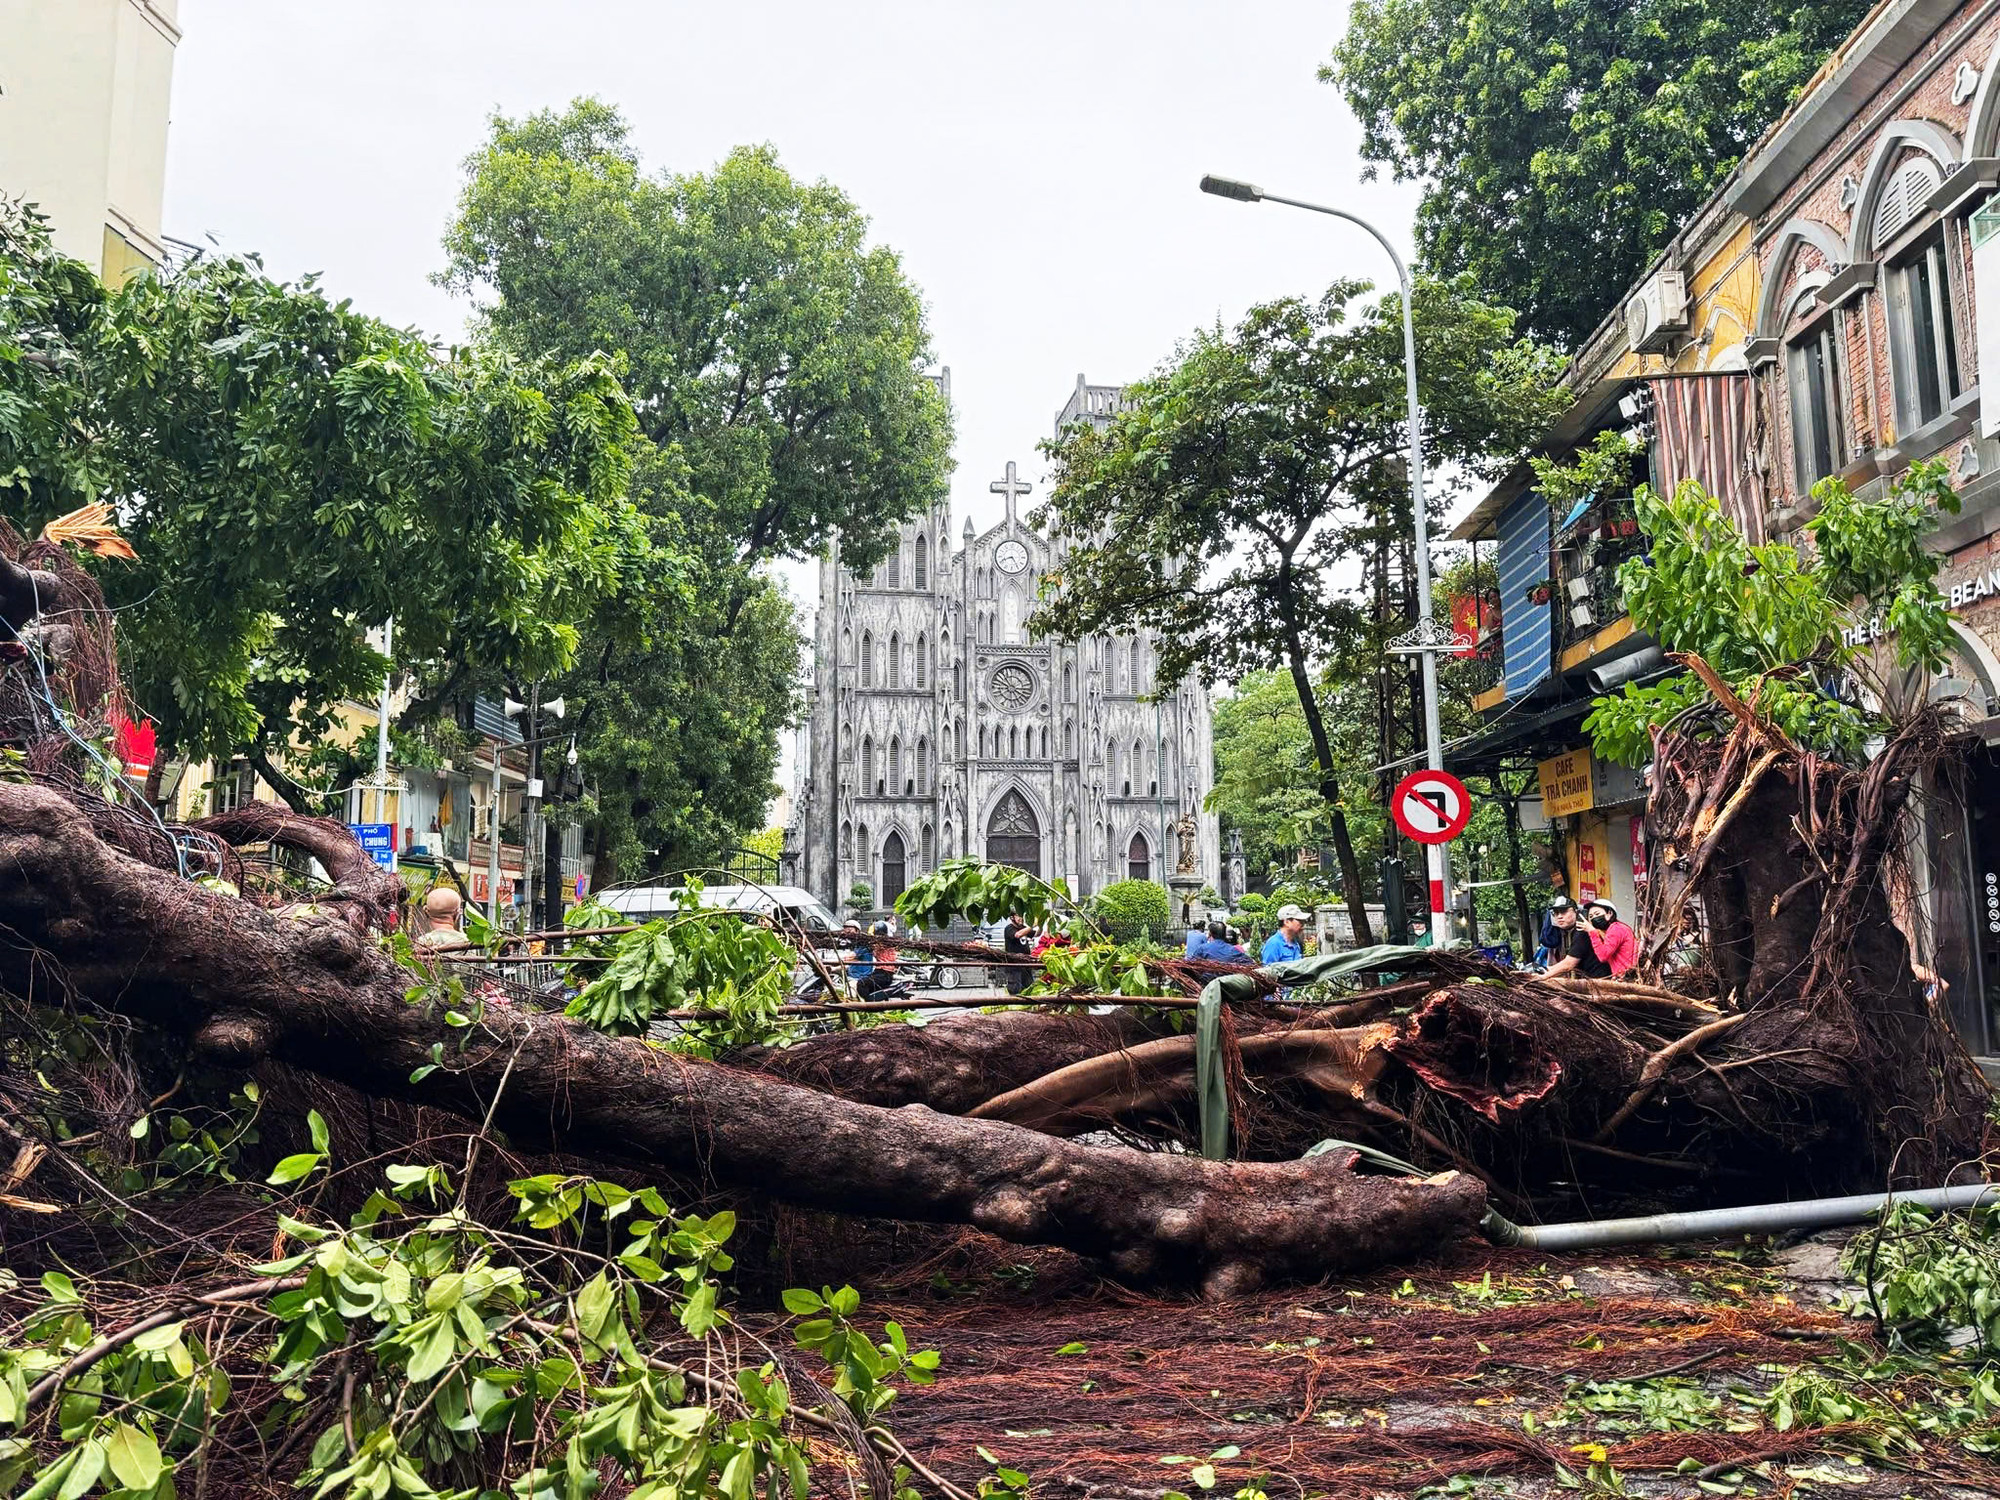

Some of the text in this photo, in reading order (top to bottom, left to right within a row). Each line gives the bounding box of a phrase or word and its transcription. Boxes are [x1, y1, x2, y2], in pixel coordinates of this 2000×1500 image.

[1841, 567, 2000, 649] THE BEAN
[1555, 757, 1574, 778] CAFE
[1545, 775, 1588, 801] TRÀ CHANH
[365, 837, 387, 846] CHUNG
